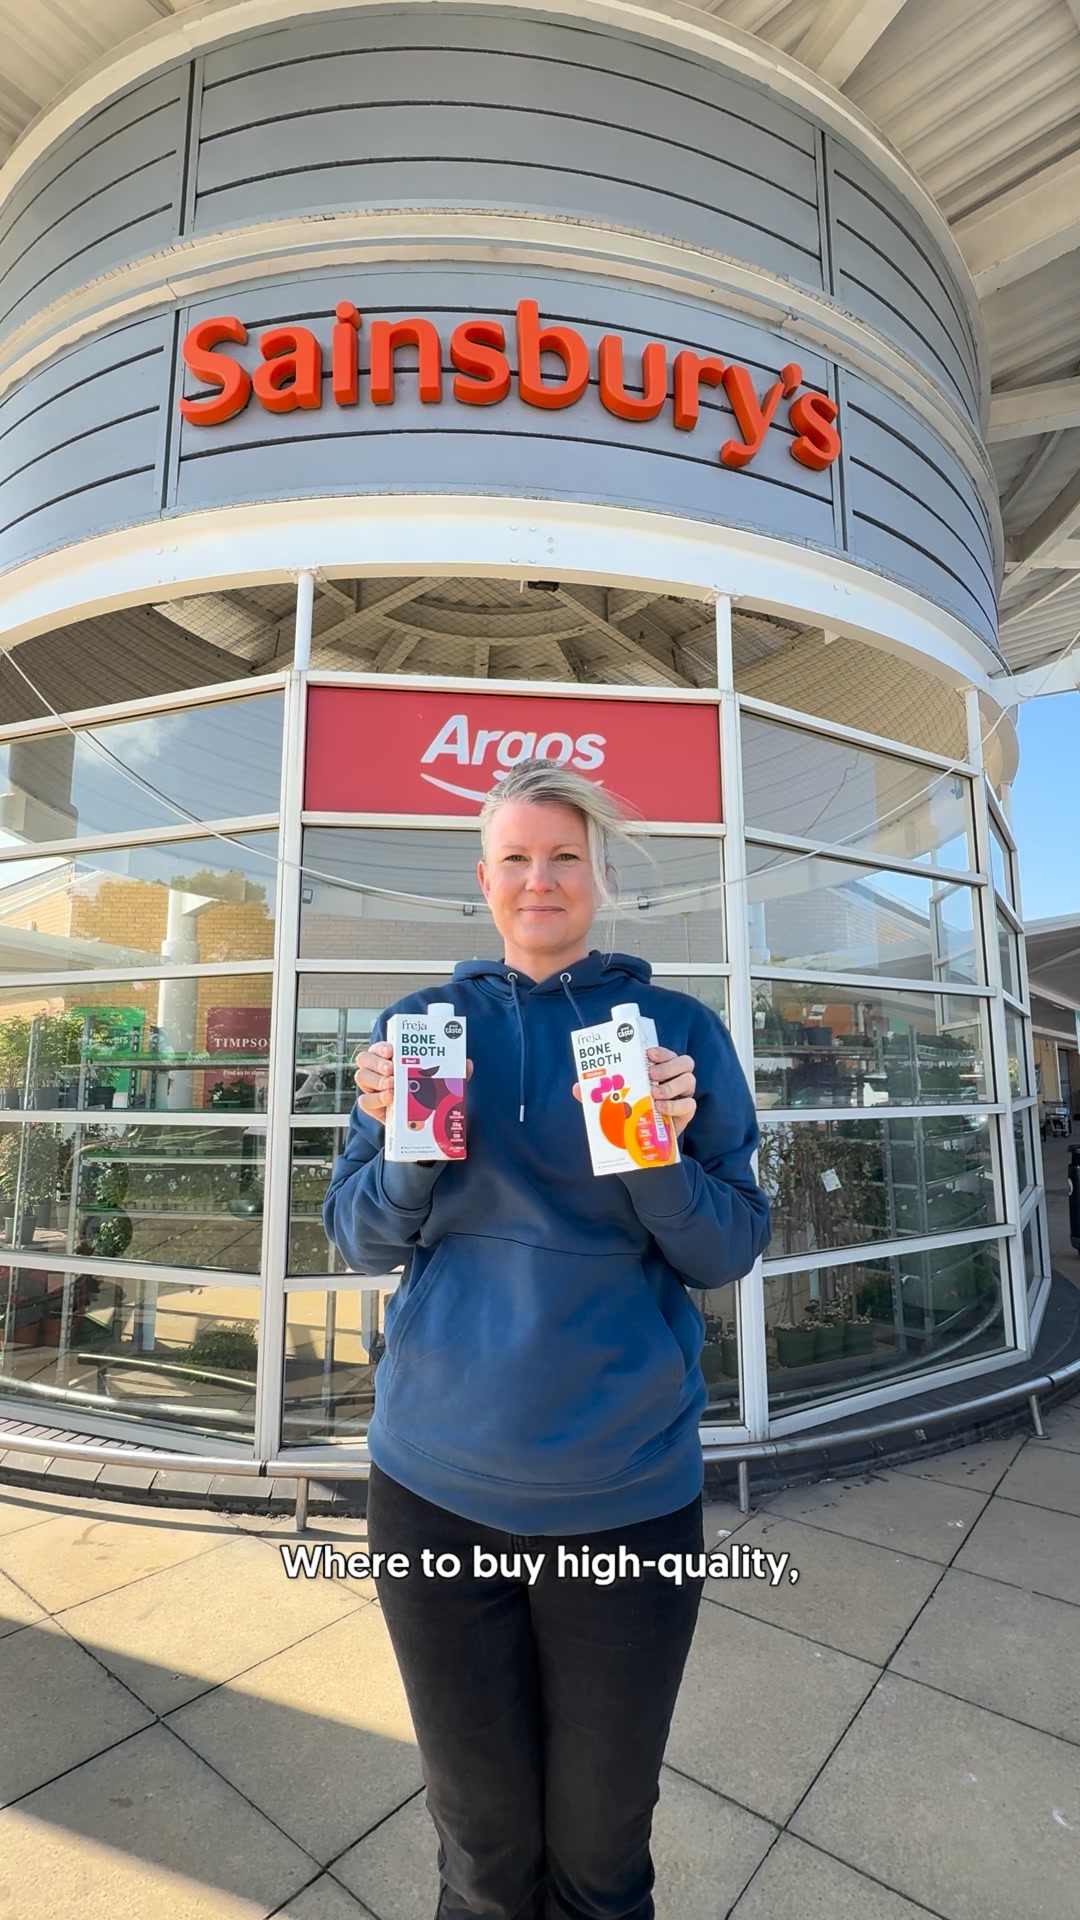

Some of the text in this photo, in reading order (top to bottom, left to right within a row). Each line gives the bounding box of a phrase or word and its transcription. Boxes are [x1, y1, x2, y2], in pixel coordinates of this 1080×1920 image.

[180, 300, 841, 471] Sainsbury's
[420, 714, 608, 783] Argos
[401, 1020, 428, 1031] freja
[214, 1038, 271, 1048] TIMPSO
[401, 1033, 436, 1045] BONE
[577, 1031, 602, 1046] freja
[401, 1046, 446, 1057] BROTH
[579, 1042, 612, 1059] BONE
[580, 1052, 622, 1071] BROTH
